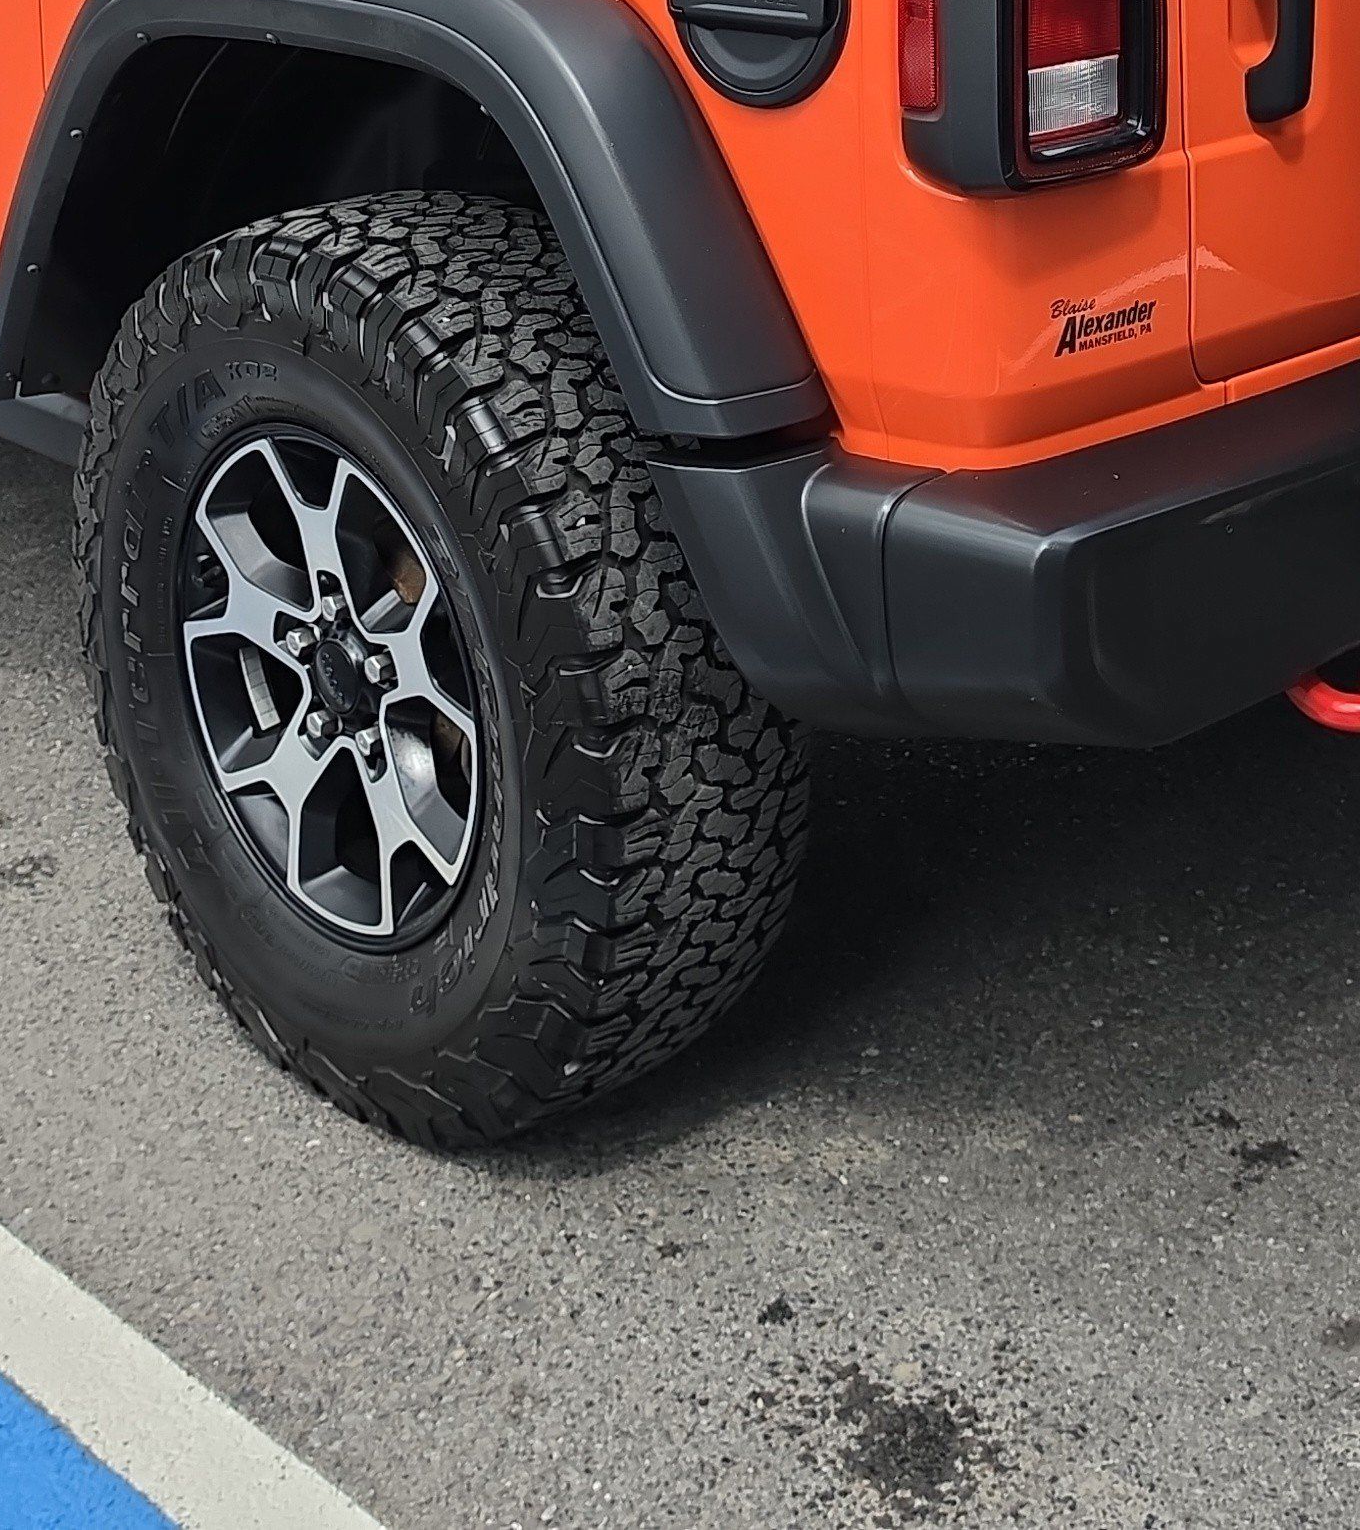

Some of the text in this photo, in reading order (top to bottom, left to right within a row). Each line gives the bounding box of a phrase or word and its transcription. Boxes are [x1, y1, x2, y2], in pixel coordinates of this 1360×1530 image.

[1050, 298, 1096, 319] Blaise
[1054, 300, 1157, 357] Alexander
[1078, 322, 1152, 352] MANSFIELD, PA
